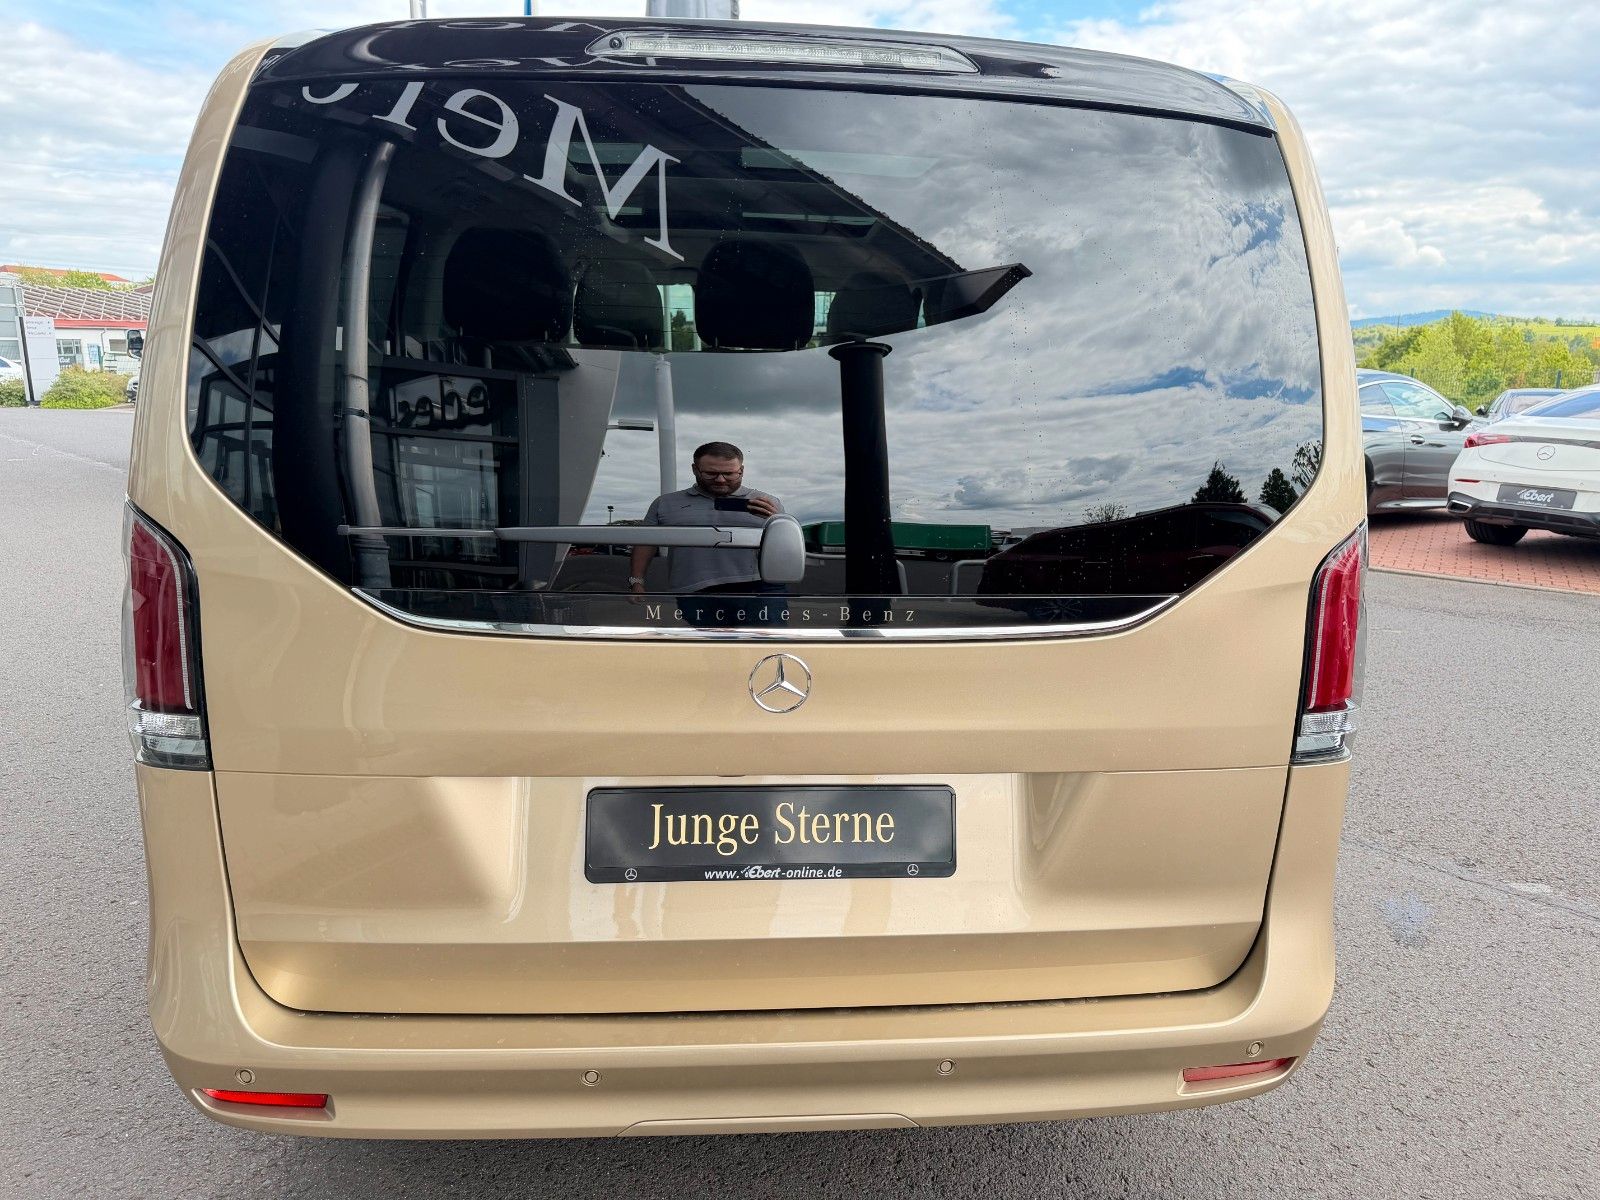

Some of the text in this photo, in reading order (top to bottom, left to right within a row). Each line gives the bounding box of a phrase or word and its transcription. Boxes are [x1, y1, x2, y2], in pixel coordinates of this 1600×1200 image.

[645, 604, 915, 622] Mercedes-Benz
[648, 802, 896, 856] Junge Sterne
